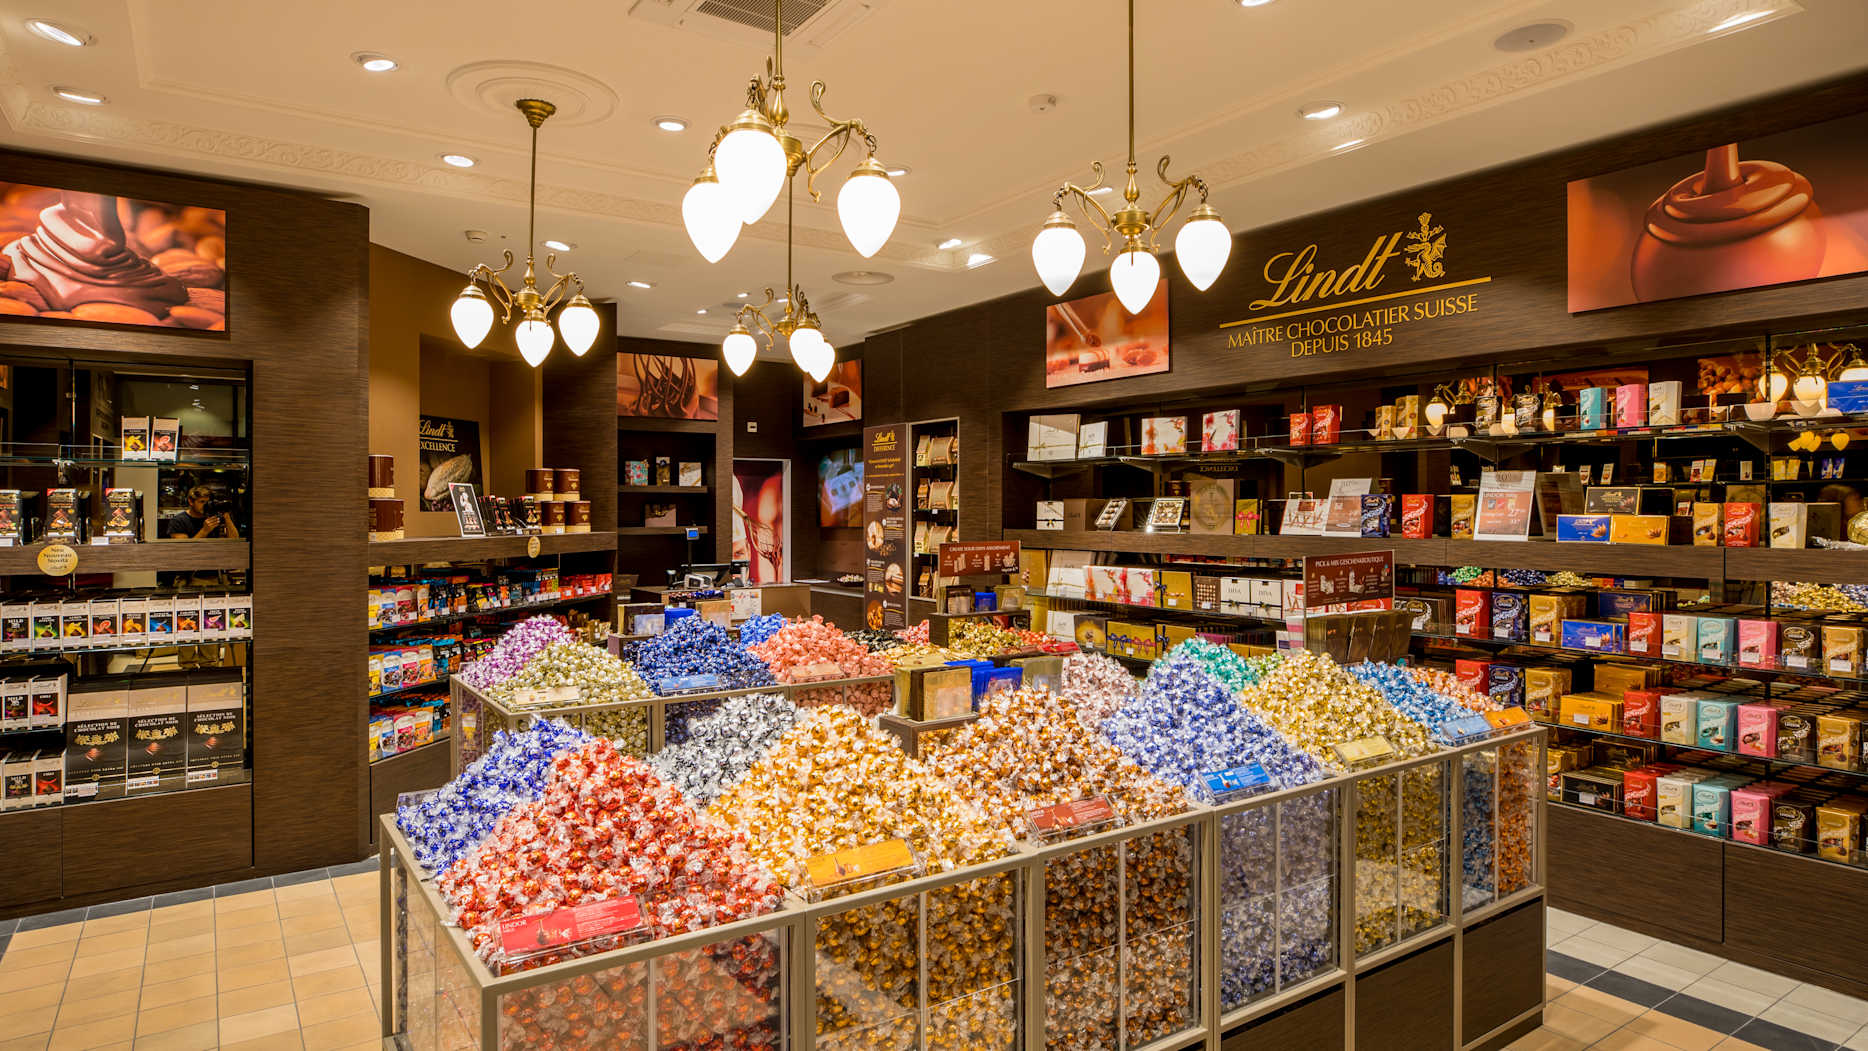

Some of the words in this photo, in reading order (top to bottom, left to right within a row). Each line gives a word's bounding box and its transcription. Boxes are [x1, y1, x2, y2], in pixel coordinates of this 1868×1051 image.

[1249, 231, 1403, 310] Lindt
[1227, 324, 1284, 349] MAÎTRE
[1286, 305, 1410, 339] CHOCOLATIER
[1413, 293, 1479, 321] SUISSE
[1290, 334, 1350, 358] DEPUIS
[1353, 328, 1393, 349] 1845
[418, 420, 446, 437] Lindt
[418, 440, 456, 452] XCELLENCE
[503, 919, 527, 929] LINDOR
